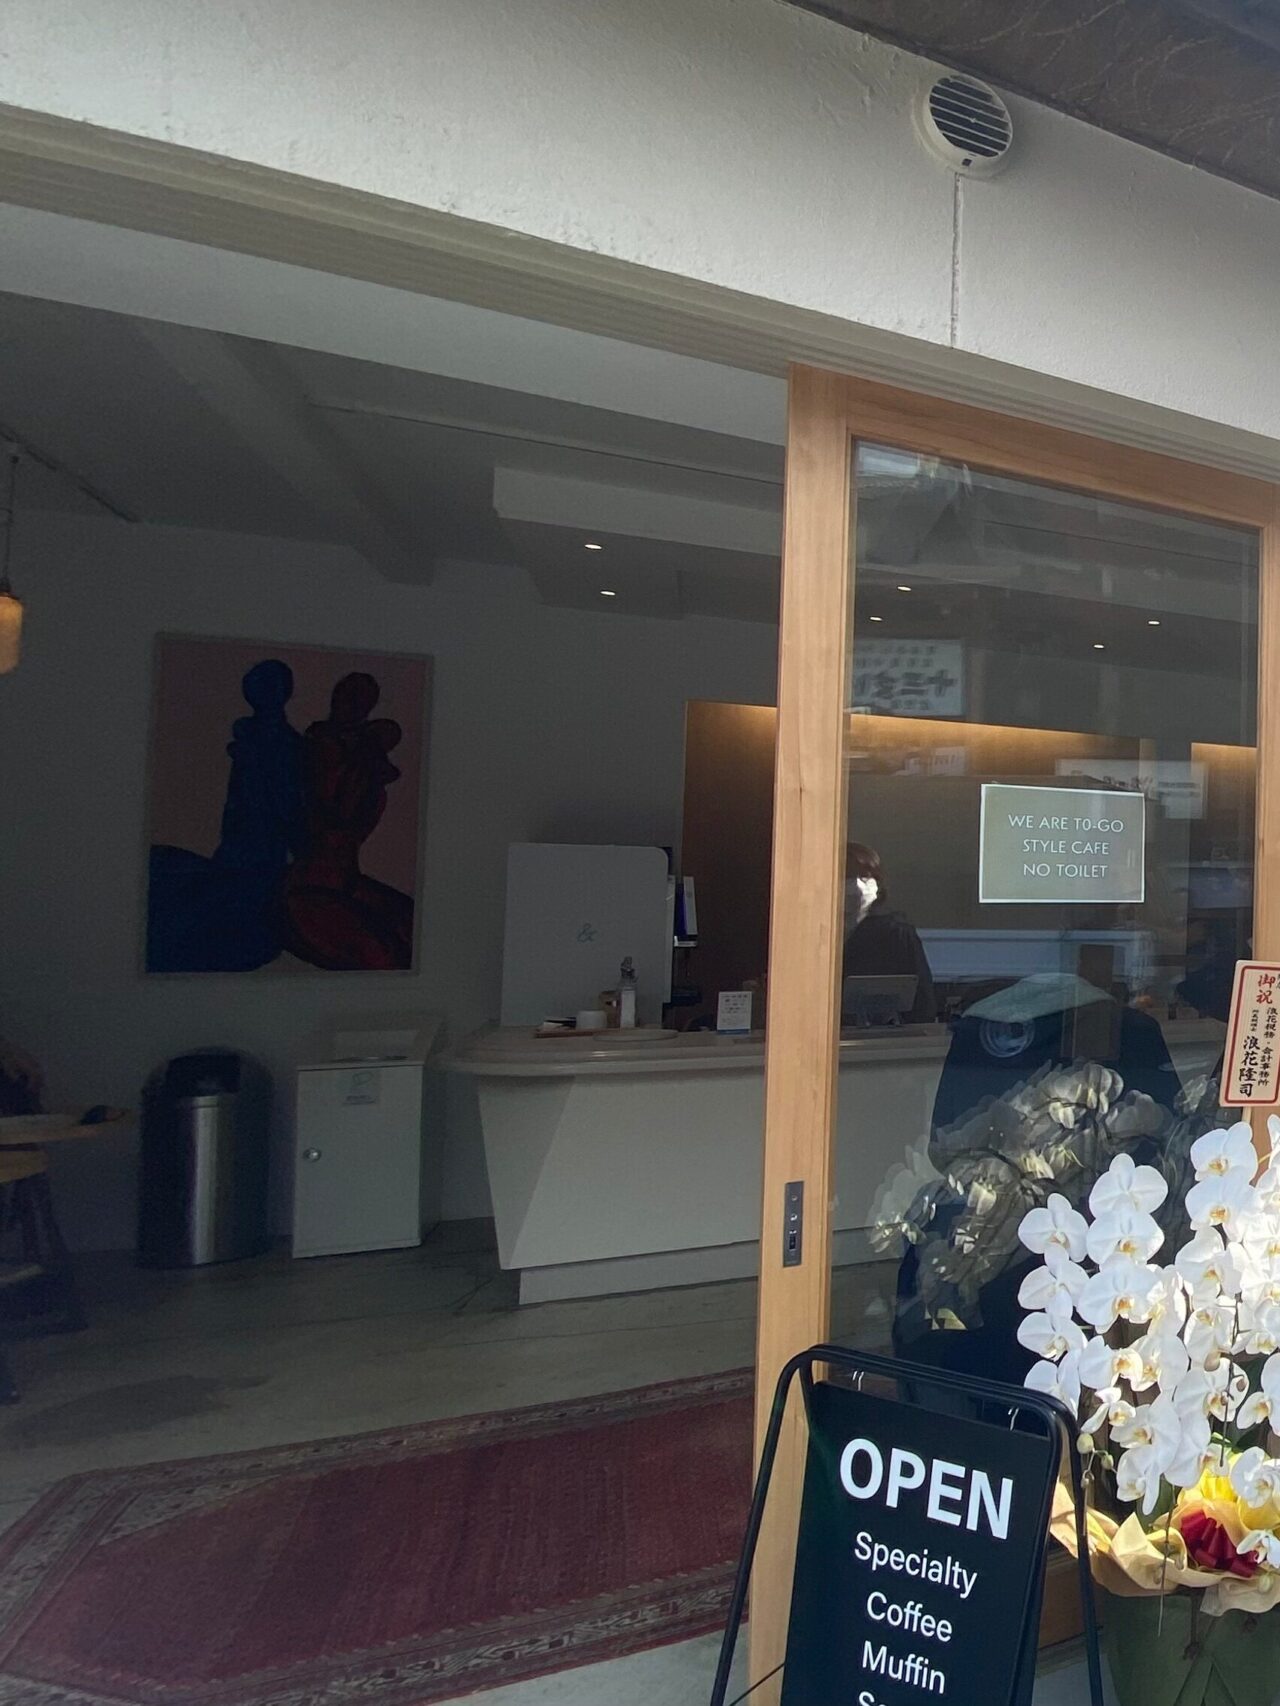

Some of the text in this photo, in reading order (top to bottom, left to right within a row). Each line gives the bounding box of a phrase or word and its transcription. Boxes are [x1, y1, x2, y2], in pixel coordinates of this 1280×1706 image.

[1008, 814, 1034, 829] WE
[1038, 816, 1069, 831] ARE
[1022, 838, 1110, 855] STYLE CAFE
[1023, 863, 1109, 878] NO TOILET
[1256, 973, 1276, 1005] 御祝
[839, 1437, 1014, 1540] OPEN
[853, 1531, 978, 1600] Specialty
[866, 1590, 953, 1643] Coffee
[861, 1639, 946, 1695] Muffin
